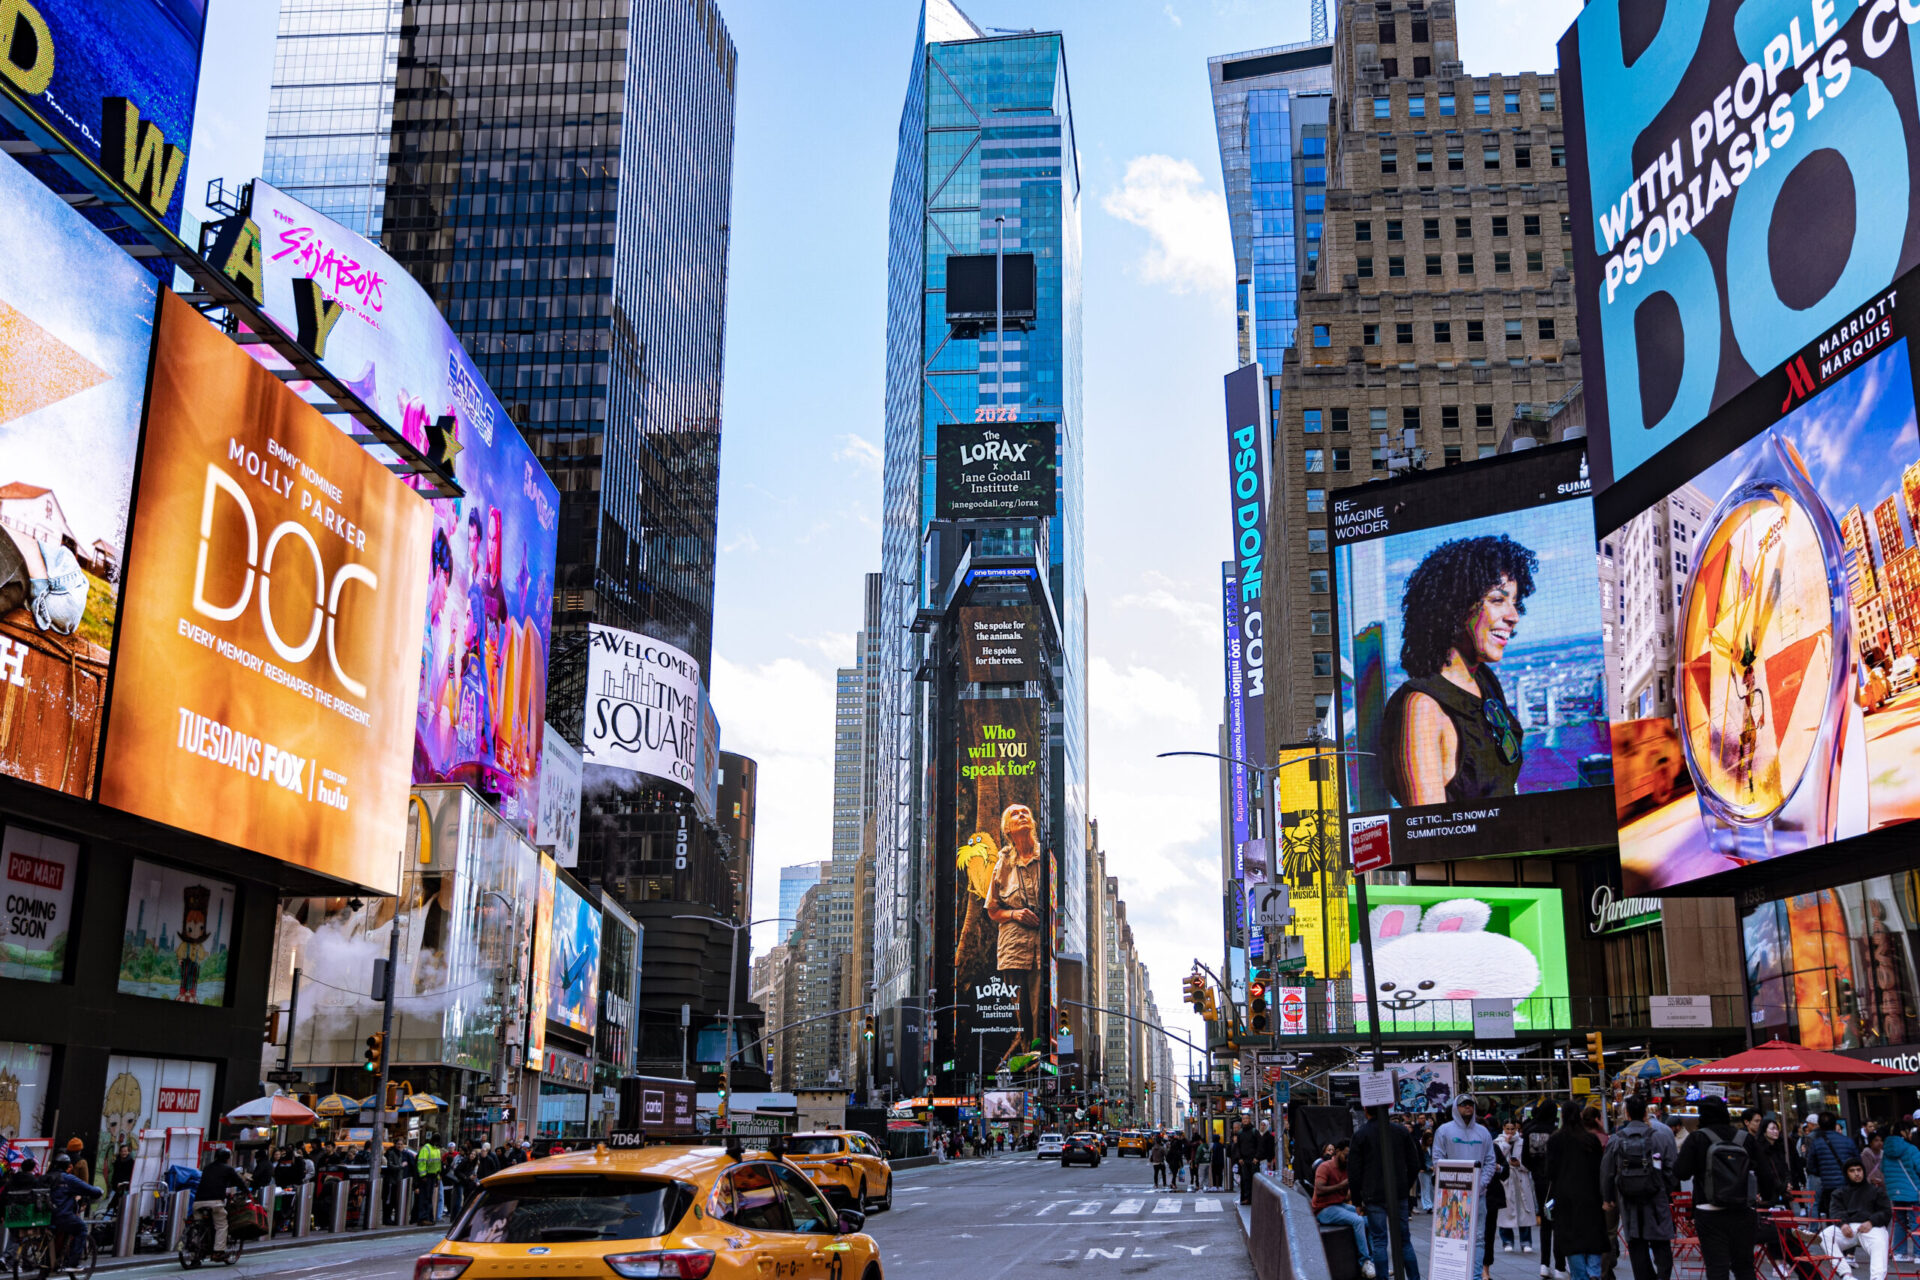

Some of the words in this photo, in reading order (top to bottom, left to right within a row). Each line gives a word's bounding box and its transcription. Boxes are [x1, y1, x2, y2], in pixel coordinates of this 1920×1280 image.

[1600, 138, 1683, 252] WITH
[1691, 0, 1839, 168] PEOPLE
[1605, 92, 1795, 304] PSORIASIS
[1802, 39, 1852, 121] IS
[272, 208, 295, 226] THE
[358, 310, 381, 331] MEAL
[1819, 290, 1897, 358] MARRIOTT
[1821, 320, 1891, 379] MARQUIS
[974, 407, 1018, 423] 2026
[983, 430, 1001, 442] The
[300, 463, 343, 505] NOMINEE
[961, 472, 985, 485] Jane
[987, 471, 1031, 482] Goodall
[228, 437, 295, 499] MOLLY
[300, 489, 367, 553] PARKER
[971, 483, 1019, 494] Institute
[951, 499, 1039, 511] janegoodall.org/lorax
[1334, 506, 1384, 526] IMAGINE
[1335, 519, 1389, 540] WONDER
[193, 462, 378, 699] DOC
[1007, 569, 1030, 577] square
[974, 621, 989, 630] She
[989, 621, 1012, 632] spoke
[1013, 620, 1025, 630] for
[976, 632, 989, 641] the
[990, 631, 1023, 641] animals.
[599, 630, 687, 678] WELCOME
[689, 665, 699, 686] TO
[982, 646, 993, 655] He
[994, 646, 1017, 656] spoke
[1231, 638, 1240, 658] 100
[975, 656, 988, 665] for
[988, 656, 1001, 665] the
[1002, 656, 1024, 665] trees.
[177, 618, 216, 649] EVERY
[216, 637, 264, 673] MEMORY
[263, 661, 315, 699] RESHAPES
[314, 687, 333, 709] THE
[333, 697, 371, 728] PRESENT.
[1232, 660, 1241, 697] million
[655, 681, 697, 727] TIMES
[1234, 698, 1242, 733] streaming
[593, 698, 695, 767] SQUARE
[982, 724, 1016, 739] Who
[177, 707, 262, 777] TUESDAYS
[261, 742, 307, 794] FOX
[316, 780, 349, 811] hulu
[968, 742, 996, 758] will
[997, 742, 1027, 758] YOU
[962, 761, 1006, 780] speak
[1007, 760, 1036, 776] for?
[1236, 790, 1244, 822] counting
[1406, 816, 1424, 826] GET
[1464, 810, 1486, 820] NOW
[1487, 808, 1500, 818] AT
[1406, 824, 1476, 839] SUMMITOV.COM
[675, 815, 688, 870] 1500
[10, 857, 32, 878] POP
[32, 862, 63, 886] MART
[1293, 889, 1320, 899] MUSICAL
[6, 894, 57, 921] COMING
[10, 916, 47, 940] SOON
[1261, 914, 1284, 922] ONLY
[990, 975, 1001, 983] The
[976, 1004, 992, 1012] Jane
[992, 1003, 1020, 1011] Goodall
[982, 1011, 1013, 1019] Institute
[1741, 1065, 1801, 1073] SQUARE
[159, 1091, 176, 1109] POP
[176, 1092, 200, 1111] MART
[612, 1133, 641, 1146] 7D64
